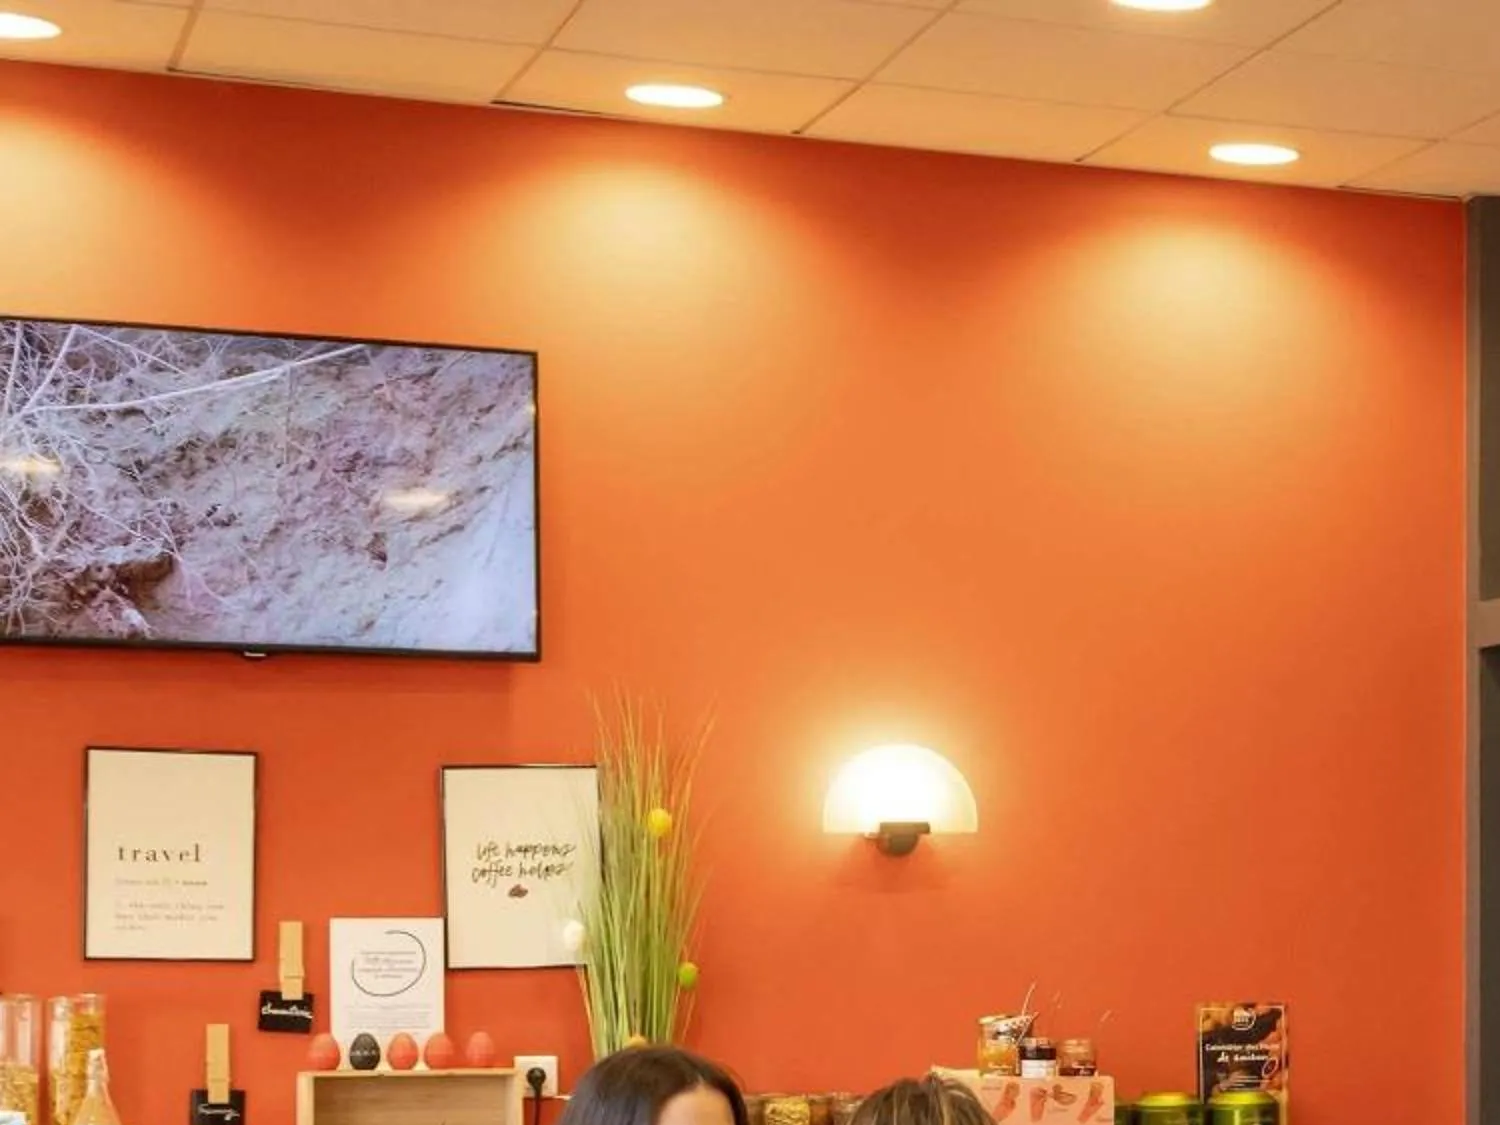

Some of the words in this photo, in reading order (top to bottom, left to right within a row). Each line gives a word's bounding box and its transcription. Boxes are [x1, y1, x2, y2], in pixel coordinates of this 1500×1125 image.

[117, 841, 202, 862] travel
[477, 841, 499, 862] life
[504, 842, 577, 860] happens
[471, 858, 512, 889] coffee
[518, 860, 575, 880] helps
